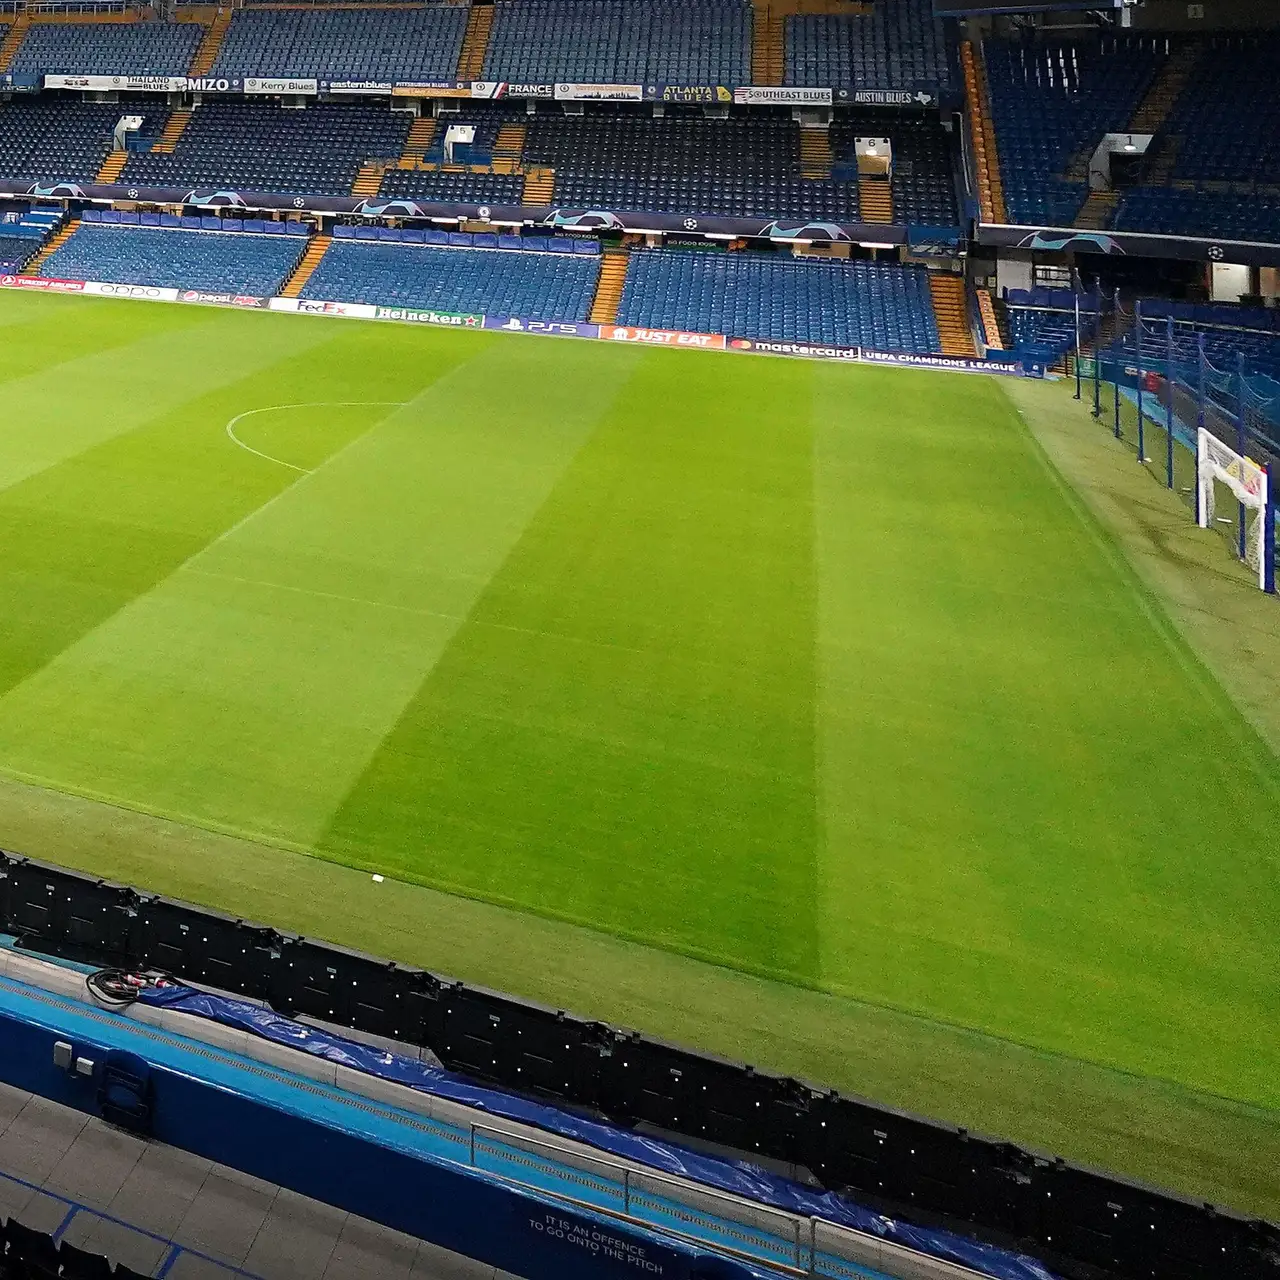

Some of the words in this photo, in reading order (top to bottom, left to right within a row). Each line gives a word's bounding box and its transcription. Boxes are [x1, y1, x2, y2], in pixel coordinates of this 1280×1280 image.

[127, 76, 170, 84] THAILAND
[188, 78, 229, 91] MIZO
[330, 81, 392, 89] easternblues
[143, 83, 169, 91] BLUES
[261, 82, 286, 91] Kerry
[288, 82, 314, 90] Blues
[508, 84, 552, 93] FRANCE
[664, 86, 712, 94] ATLANTA
[663, 94, 712, 102] BLUES
[803, 91, 831, 100] BLUES
[855, 92, 885, 103] AUSTIN
[886, 93, 912, 103] BLUES
[459, 127, 466, 135] 5
[868, 139, 876, 147] 6
[1127, 135, 1133, 145] 1
[17, 278, 48, 287] TURKISH
[49, 281, 82, 290] AIRLINES
[101, 285, 161, 299] oppo
[198, 293, 231, 303] pepsi
[297, 300, 347, 314] FedEx
[378, 308, 462, 325] Heineken
[528, 321, 577, 333] PS5
[633, 328, 676, 343] JUST
[677, 333, 712, 346] EAT
[756, 341, 856, 358] mastercard
[865, 352, 897, 361] UEFA
[898, 355, 966, 368] CHAMPIONS
[969, 360, 1016, 372] LEAGUE
[545, 1214, 556, 1225] IT
[558, 1220, 570, 1231] IS
[573, 1225, 589, 1237] AN
[591, 1231, 645, 1258] OFFENCE
[529, 1219, 544, 1231] TO
[547, 1226, 564, 1238] GO
[567, 1233, 600, 1252] ONTO
[603, 1245, 624, 1261] THE
[627, 1254, 664, 1275] PITCH
